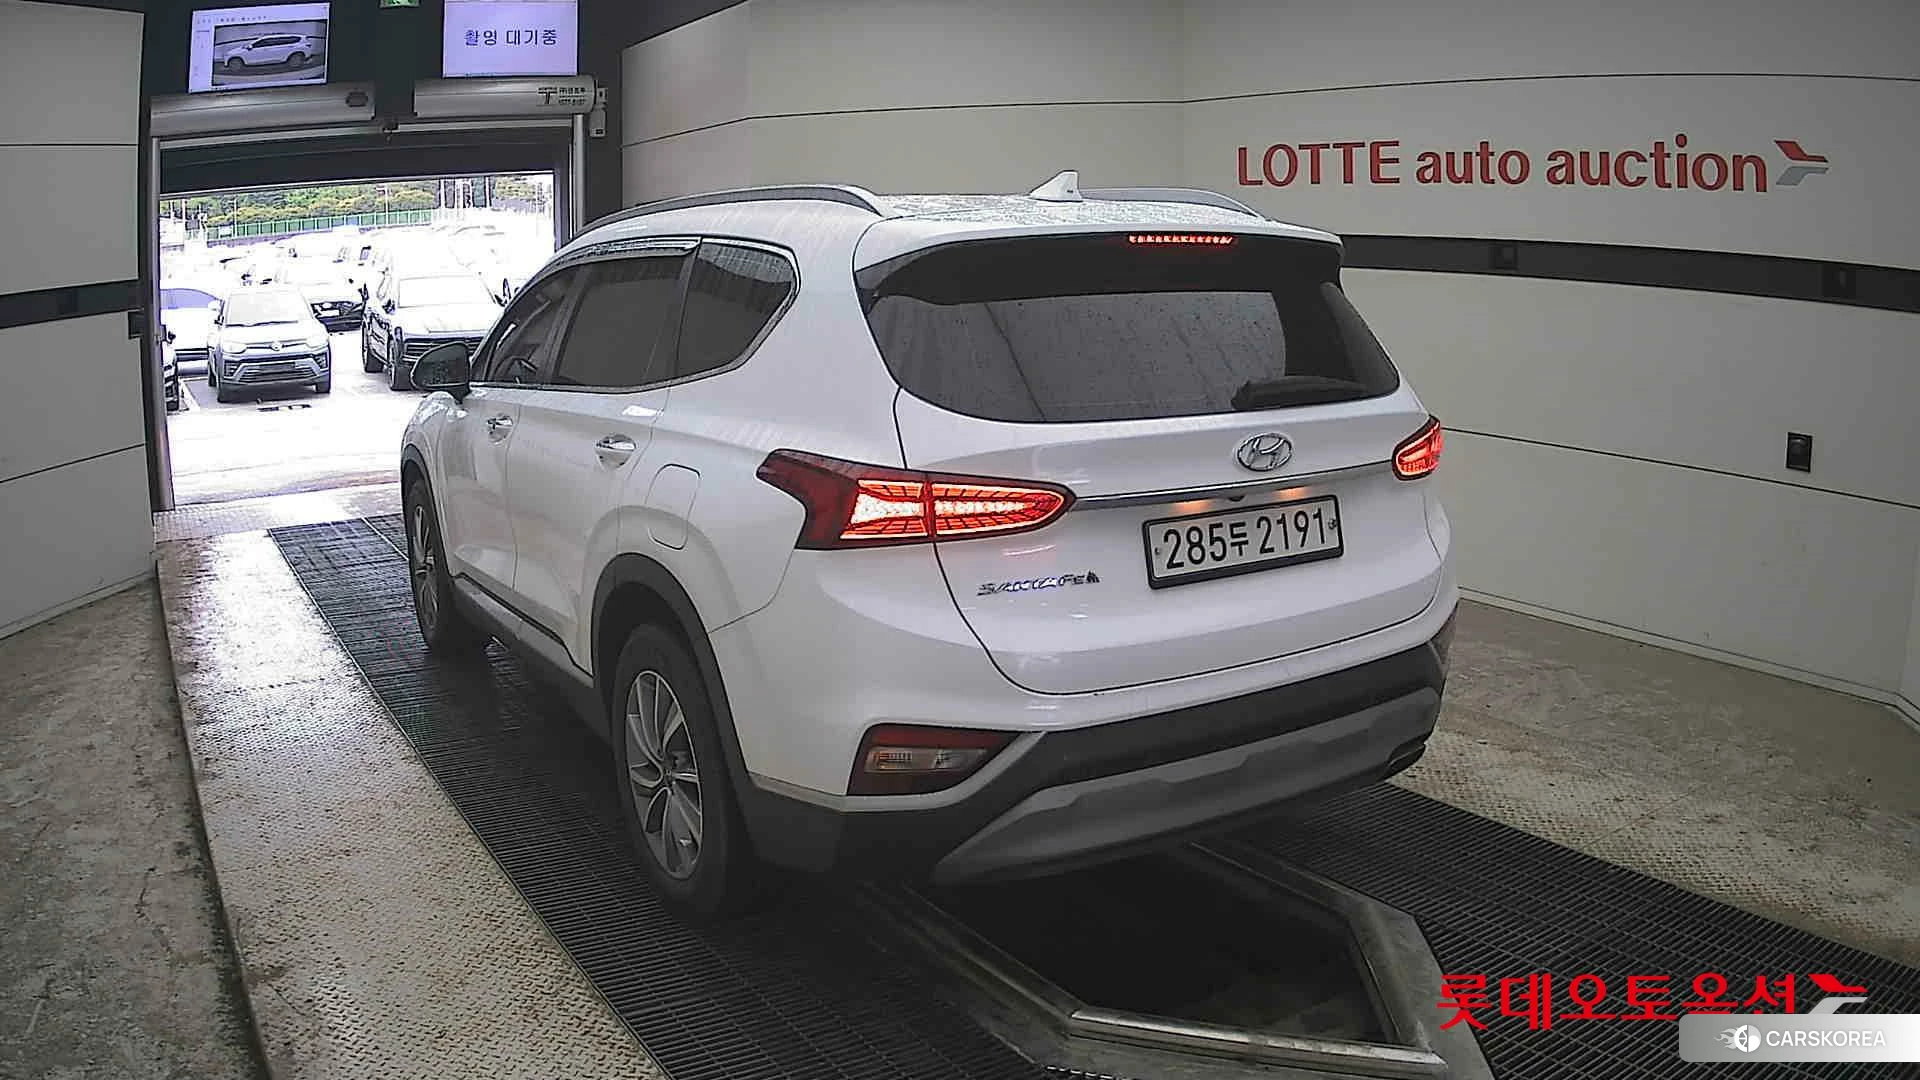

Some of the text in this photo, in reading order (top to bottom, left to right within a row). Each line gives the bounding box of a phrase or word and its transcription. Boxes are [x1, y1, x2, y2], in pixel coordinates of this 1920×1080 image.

[465, 29, 557, 46] 촬영 대기중
[1237, 134, 1767, 193] LOTTE auto auction
[1163, 508, 1326, 569] 285두 2191
